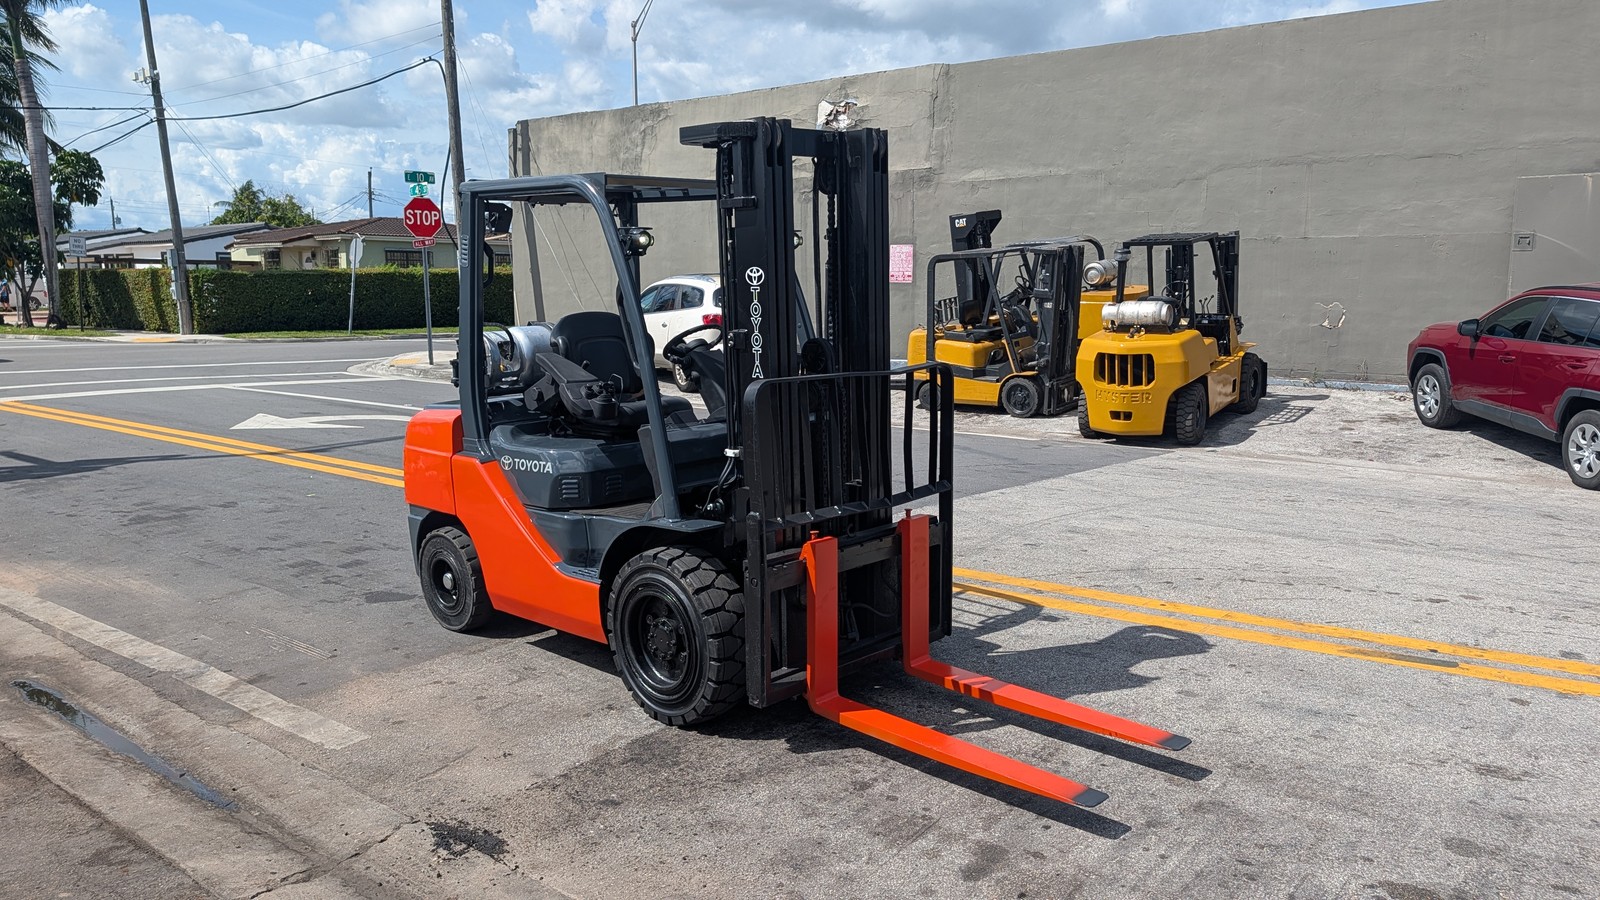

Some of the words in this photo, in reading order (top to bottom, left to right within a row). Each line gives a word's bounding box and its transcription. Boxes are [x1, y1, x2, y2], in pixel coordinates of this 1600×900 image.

[416, 172, 424, 182] 10
[406, 209, 439, 226] STOP
[955, 217, 967, 228] CAT
[750, 286, 764, 379] TOYOTA
[1095, 389, 1153, 404] HYSTER
[514, 458, 553, 474] TOYOTA
